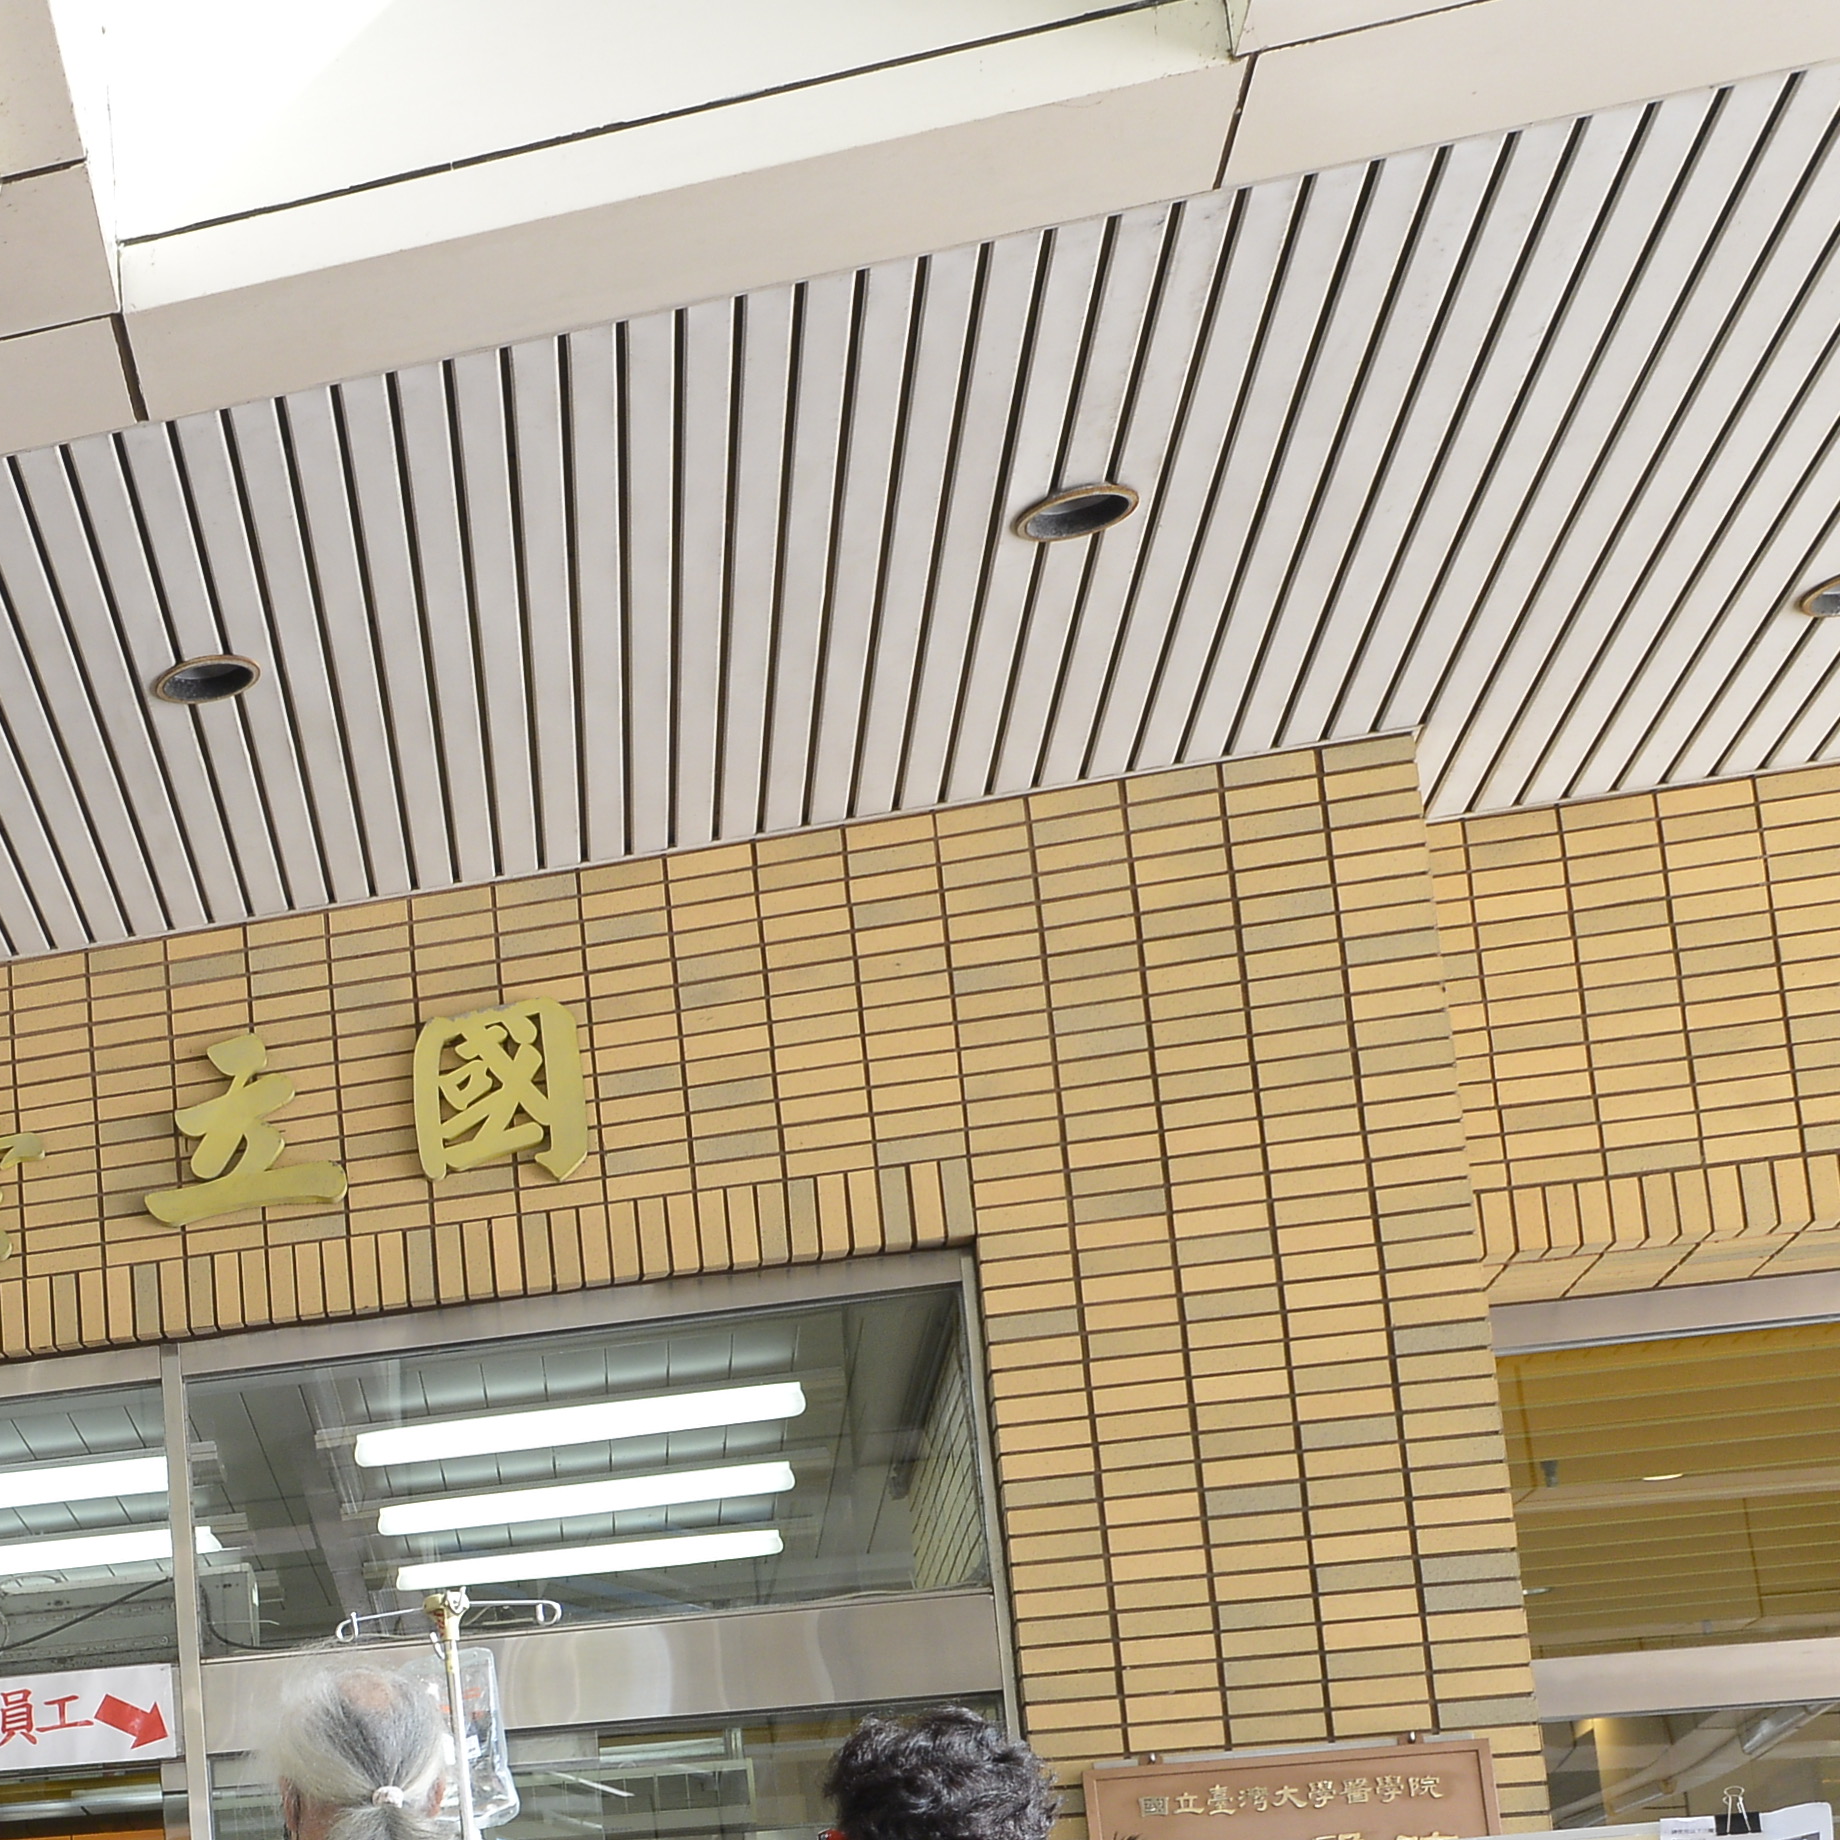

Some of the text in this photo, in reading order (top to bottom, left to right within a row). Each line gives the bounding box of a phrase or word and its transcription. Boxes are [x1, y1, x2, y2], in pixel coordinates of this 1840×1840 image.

[1138, 1773, 1444, 1818] 國立臺灣大學醫學院
